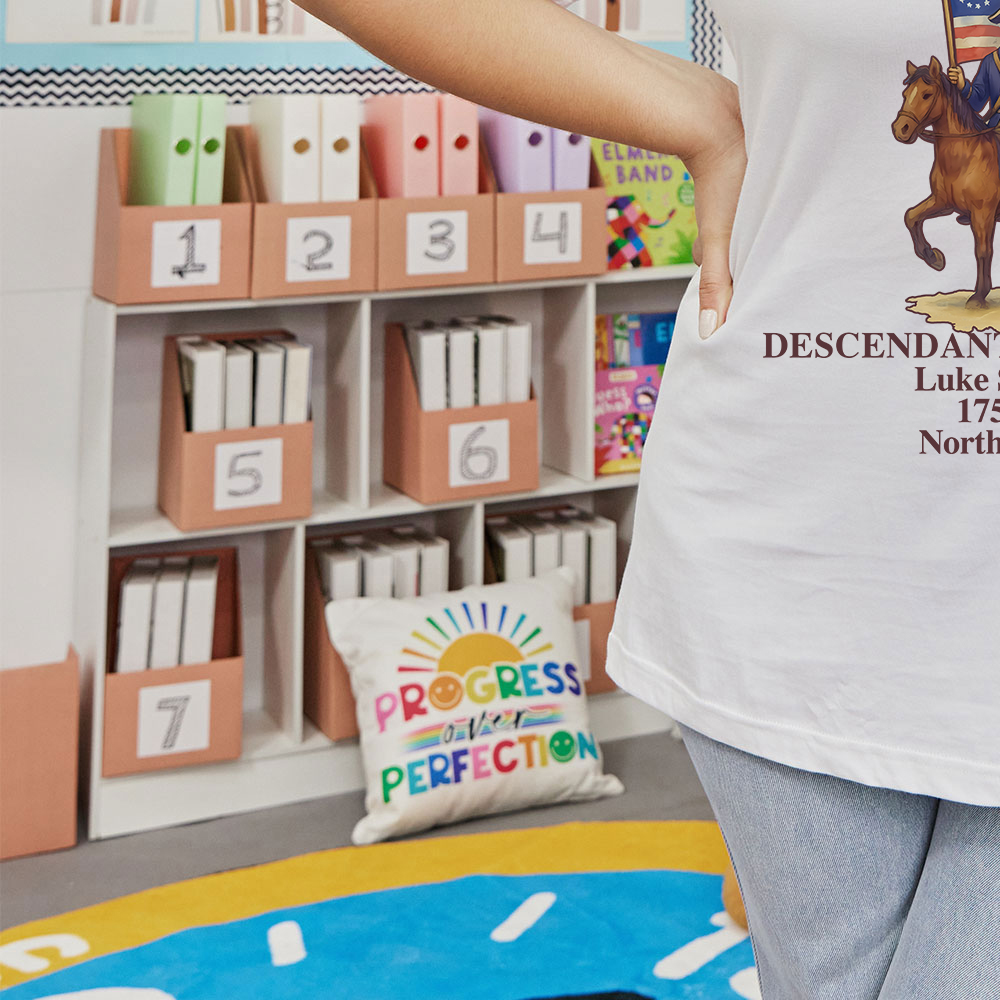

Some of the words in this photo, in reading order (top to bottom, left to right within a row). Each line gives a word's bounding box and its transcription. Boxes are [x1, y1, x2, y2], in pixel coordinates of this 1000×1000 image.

[615, 163, 673, 185] BAND
[172, 222, 208, 280] 1
[299, 228, 334, 271] 2
[422, 218, 456, 263] 3
[530, 209, 568, 255] 4
[914, 365, 991, 393] Luke
[226, 448, 265, 498] 5
[458, 423, 499, 482] 6
[375, 660, 582, 735] PROGRESS
[156, 694, 192, 750] 7
[443, 709, 532, 745] over
[381, 730, 599, 805] PERFECTION
